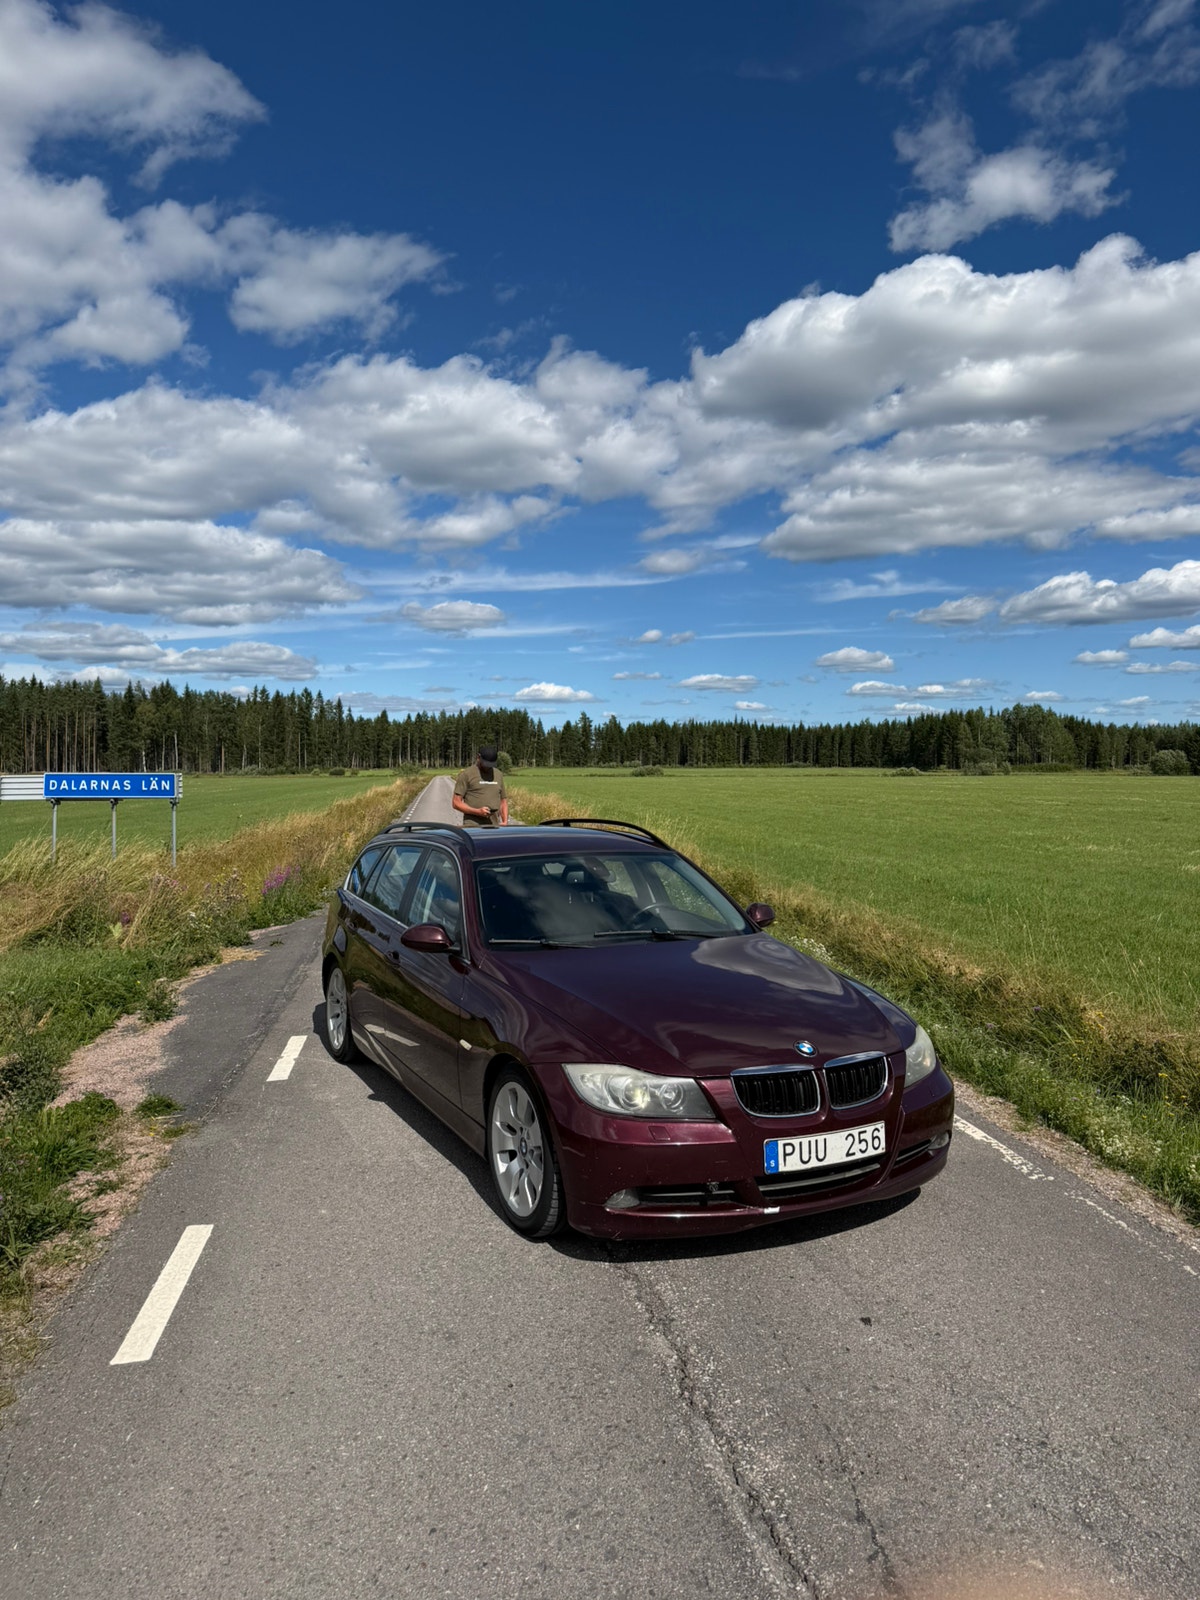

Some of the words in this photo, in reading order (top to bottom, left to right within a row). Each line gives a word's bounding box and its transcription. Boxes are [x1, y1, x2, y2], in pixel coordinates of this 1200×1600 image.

[49, 779, 132, 791] DALARNAS
[141, 776, 171, 791] LÄN
[782, 1137, 827, 1168] PUU
[845, 1127, 882, 1158] 256
